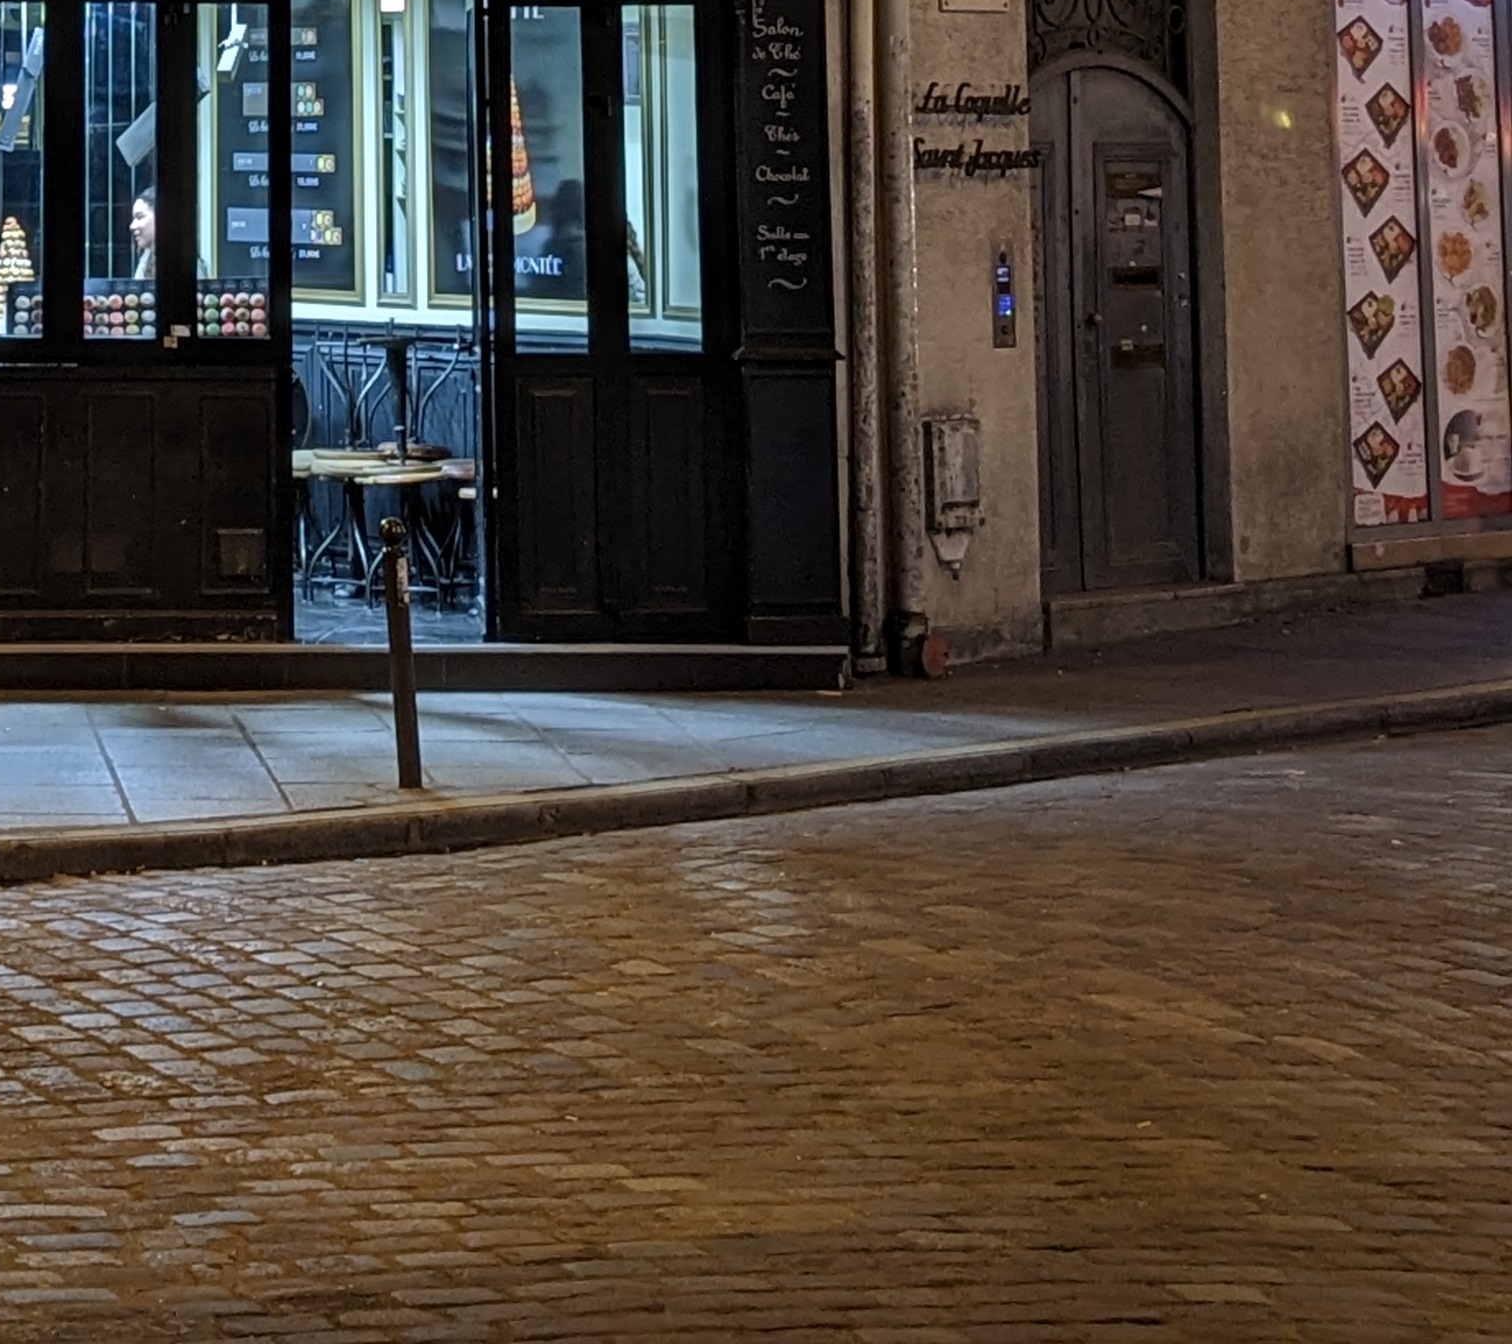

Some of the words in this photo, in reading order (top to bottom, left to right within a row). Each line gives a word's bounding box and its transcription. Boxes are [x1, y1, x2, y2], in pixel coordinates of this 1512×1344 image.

[752, 17, 804, 38] Salon
[761, 83, 795, 109] Café
[755, 165, 811, 182] Chocolat
